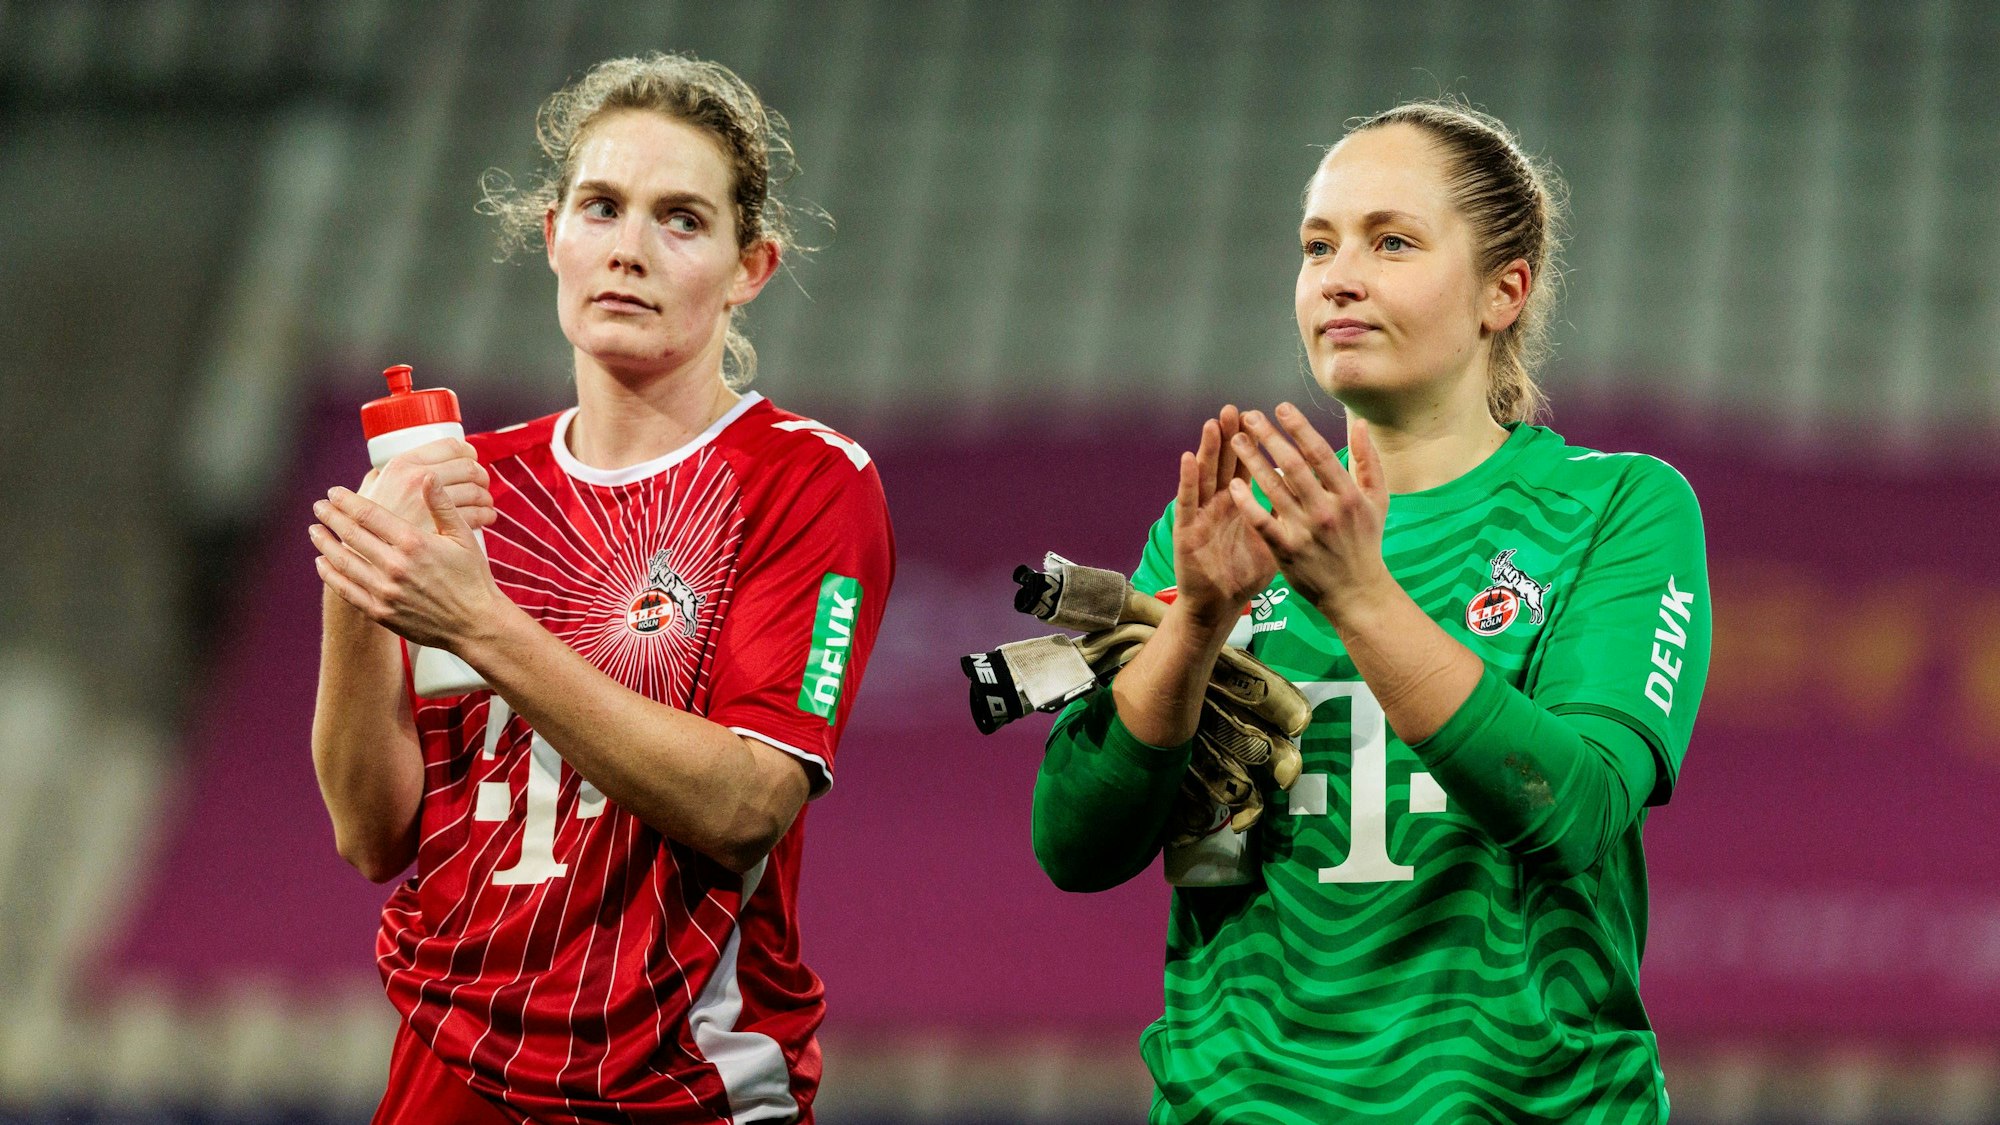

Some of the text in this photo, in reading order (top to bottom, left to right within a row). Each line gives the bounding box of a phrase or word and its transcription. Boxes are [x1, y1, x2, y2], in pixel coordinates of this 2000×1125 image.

[814, 590, 858, 706] DEVK
[1252, 616, 1288, 635] mmel
[1480, 614, 1503, 630] KÖLN
[1644, 574, 1695, 718] DEVK
